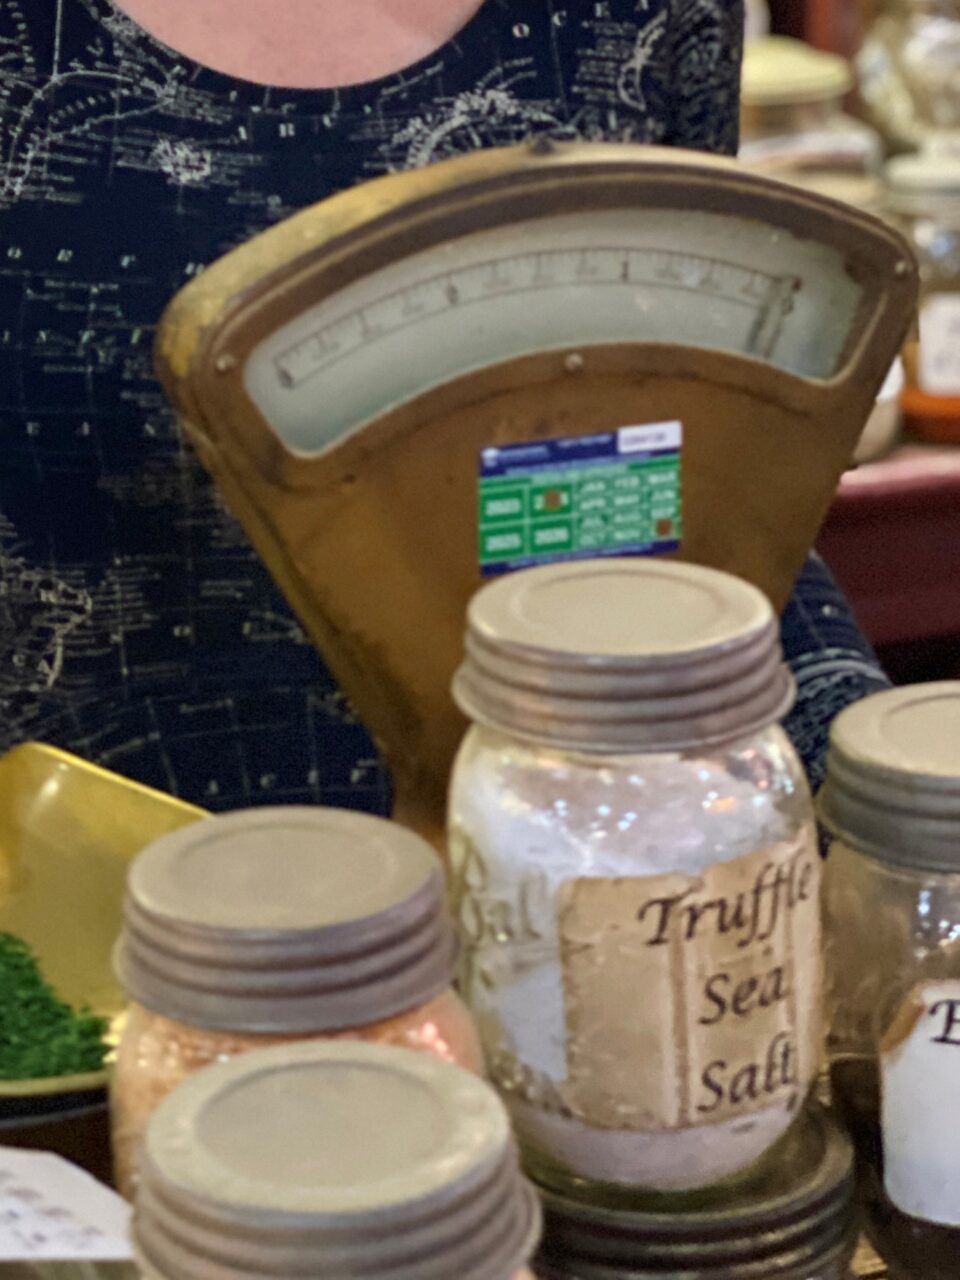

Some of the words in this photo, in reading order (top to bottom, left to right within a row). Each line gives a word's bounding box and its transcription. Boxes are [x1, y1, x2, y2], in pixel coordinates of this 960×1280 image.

[637, 848, 812, 948] Truffle
[698, 966, 785, 1025] Sea
[696, 1031, 794, 1113] Salt
